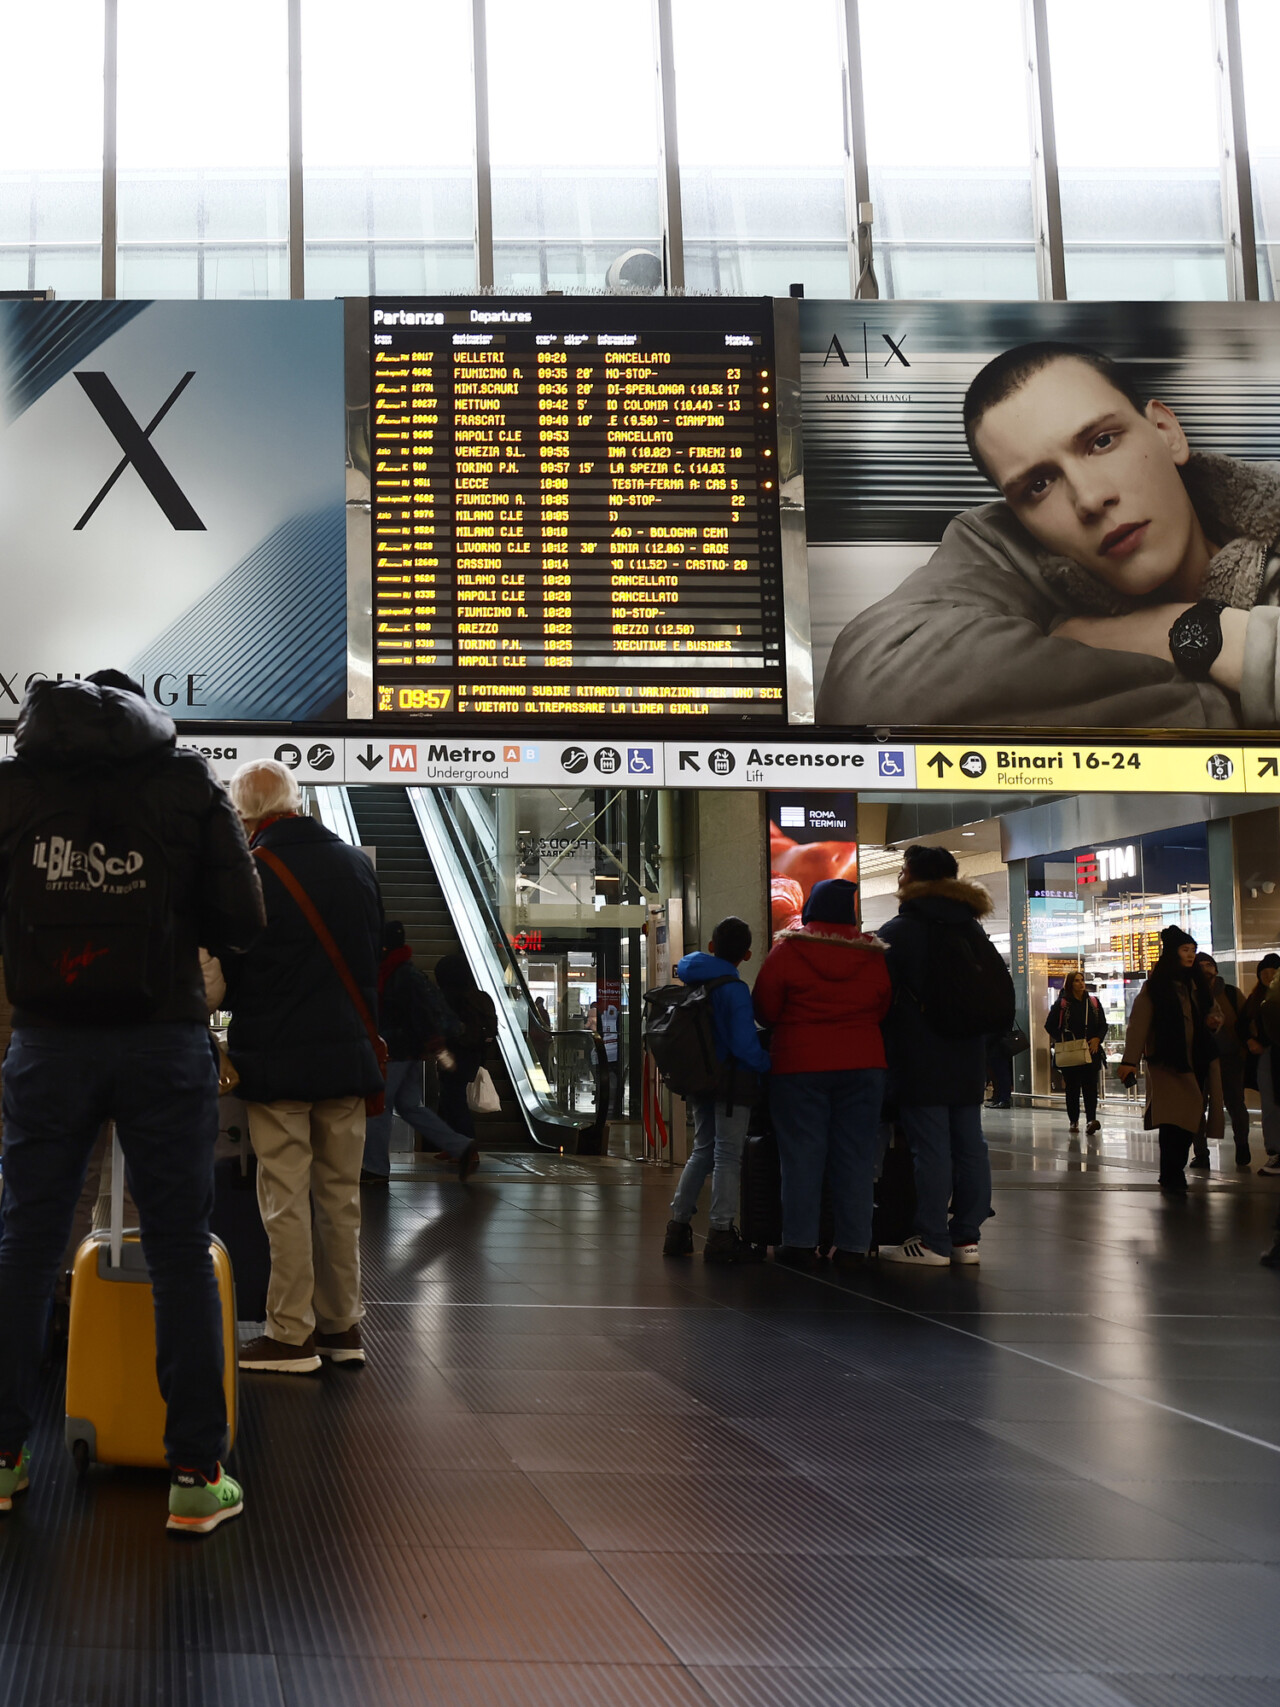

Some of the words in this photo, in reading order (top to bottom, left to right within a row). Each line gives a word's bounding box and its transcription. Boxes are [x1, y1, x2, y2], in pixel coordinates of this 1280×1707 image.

[374, 310, 444, 325] Partenze
[470, 309, 532, 324] Departures
[453, 353, 504, 363] VELLETRI
[605, 353, 670, 363] CANCELLATO
[453, 368, 507, 379] FIUMICINO
[512, 368, 523, 379] A.
[825, 394, 860, 402] ARMANI
[864, 394, 912, 402] EXCHANGE
[454, 399, 500, 410] NETTUNO
[455, 415, 505, 426] FRASCATI
[455, 431, 493, 442] NAPOLI
[498, 431, 522, 441] C.LE
[607, 431, 673, 442] CANCELLATO
[455, 446, 499, 457] VENEZIA
[505, 446, 526, 457] S.L.
[456, 463, 493, 473] TORINO
[498, 463, 519, 473] P.N.
[455, 478, 489, 489] LECCE
[455, 494, 509, 505] FIUMICINO
[515, 494, 526, 505] A.
[455, 511, 493, 521] MILANO
[500, 511, 523, 520] C.LE
[456, 527, 494, 537] MILANO
[500, 527, 523, 537] C.LE
[456, 542, 501, 553] LIVORNO
[507, 542, 530, 553] C.LE
[456, 559, 502, 569] CASSINO
[457, 575, 495, 585] MILANO
[501, 575, 525, 585] C.LE
[611, 575, 678, 586] CANCELLATO
[457, 591, 496, 601] NAPOLI
[501, 591, 525, 601] C.LE
[612, 592, 678, 602] CANCELLATO
[457, 607, 511, 617] FIUMICINO
[517, 607, 528, 617] A.
[458, 623, 499, 634] AREZZO
[458, 639, 496, 650] TORINO
[502, 640, 522, 650] P.N.
[458, 656, 497, 666] NAPOLI
[502, 656, 526, 666] C.LE
[399, 689, 451, 708] 09:57
[427, 744, 496, 762] Metro
[746, 749, 865, 767] Ascensore
[997, 751, 1063, 769] Binari
[1073, 752, 1141, 770] 16-24
[427, 766, 509, 779] Underground
[746, 770, 764, 782] Lift
[997, 773, 1054, 786] Platforms
[809, 810, 835, 819] ROMA
[809, 819, 847, 828] TERMINI
[1096, 845, 1136, 881] TIM
